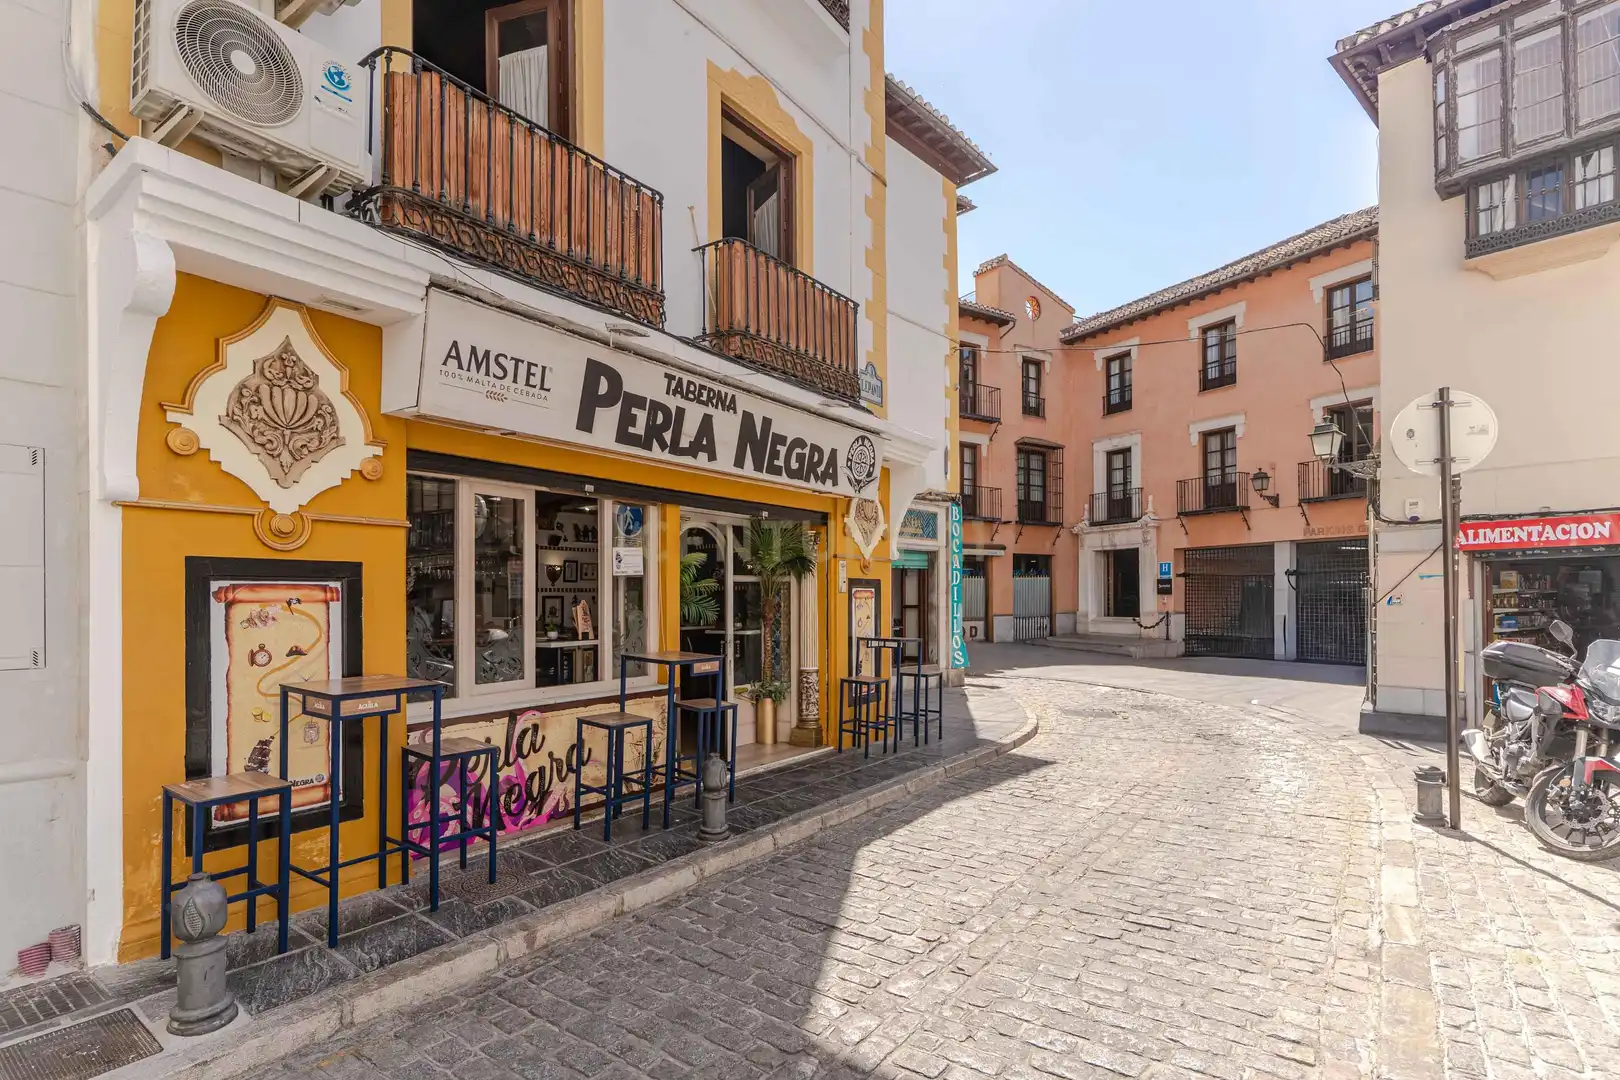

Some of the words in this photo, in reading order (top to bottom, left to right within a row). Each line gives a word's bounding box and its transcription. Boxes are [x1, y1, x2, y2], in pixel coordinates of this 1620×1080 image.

[441, 340, 551, 392] AMSTEL
[439, 369, 464, 381] 100%
[466, 376, 497, 389] MALTA
[500, 384, 512, 393] DE
[513, 387, 548, 402] CEBADA
[664, 372, 738, 415] TABERNA
[576, 357, 717, 462] PERLA
[733, 409, 839, 487] NEGRA
[848, 437, 862, 460] PERLA
[863, 437, 875, 465] NEGRA
[1459, 521, 1611, 545] ALIMENTACION
[1162, 563, 1169, 572] H
[951, 506, 964, 665] BOCADILLOS
[289, 778, 314, 787] NEGRA
